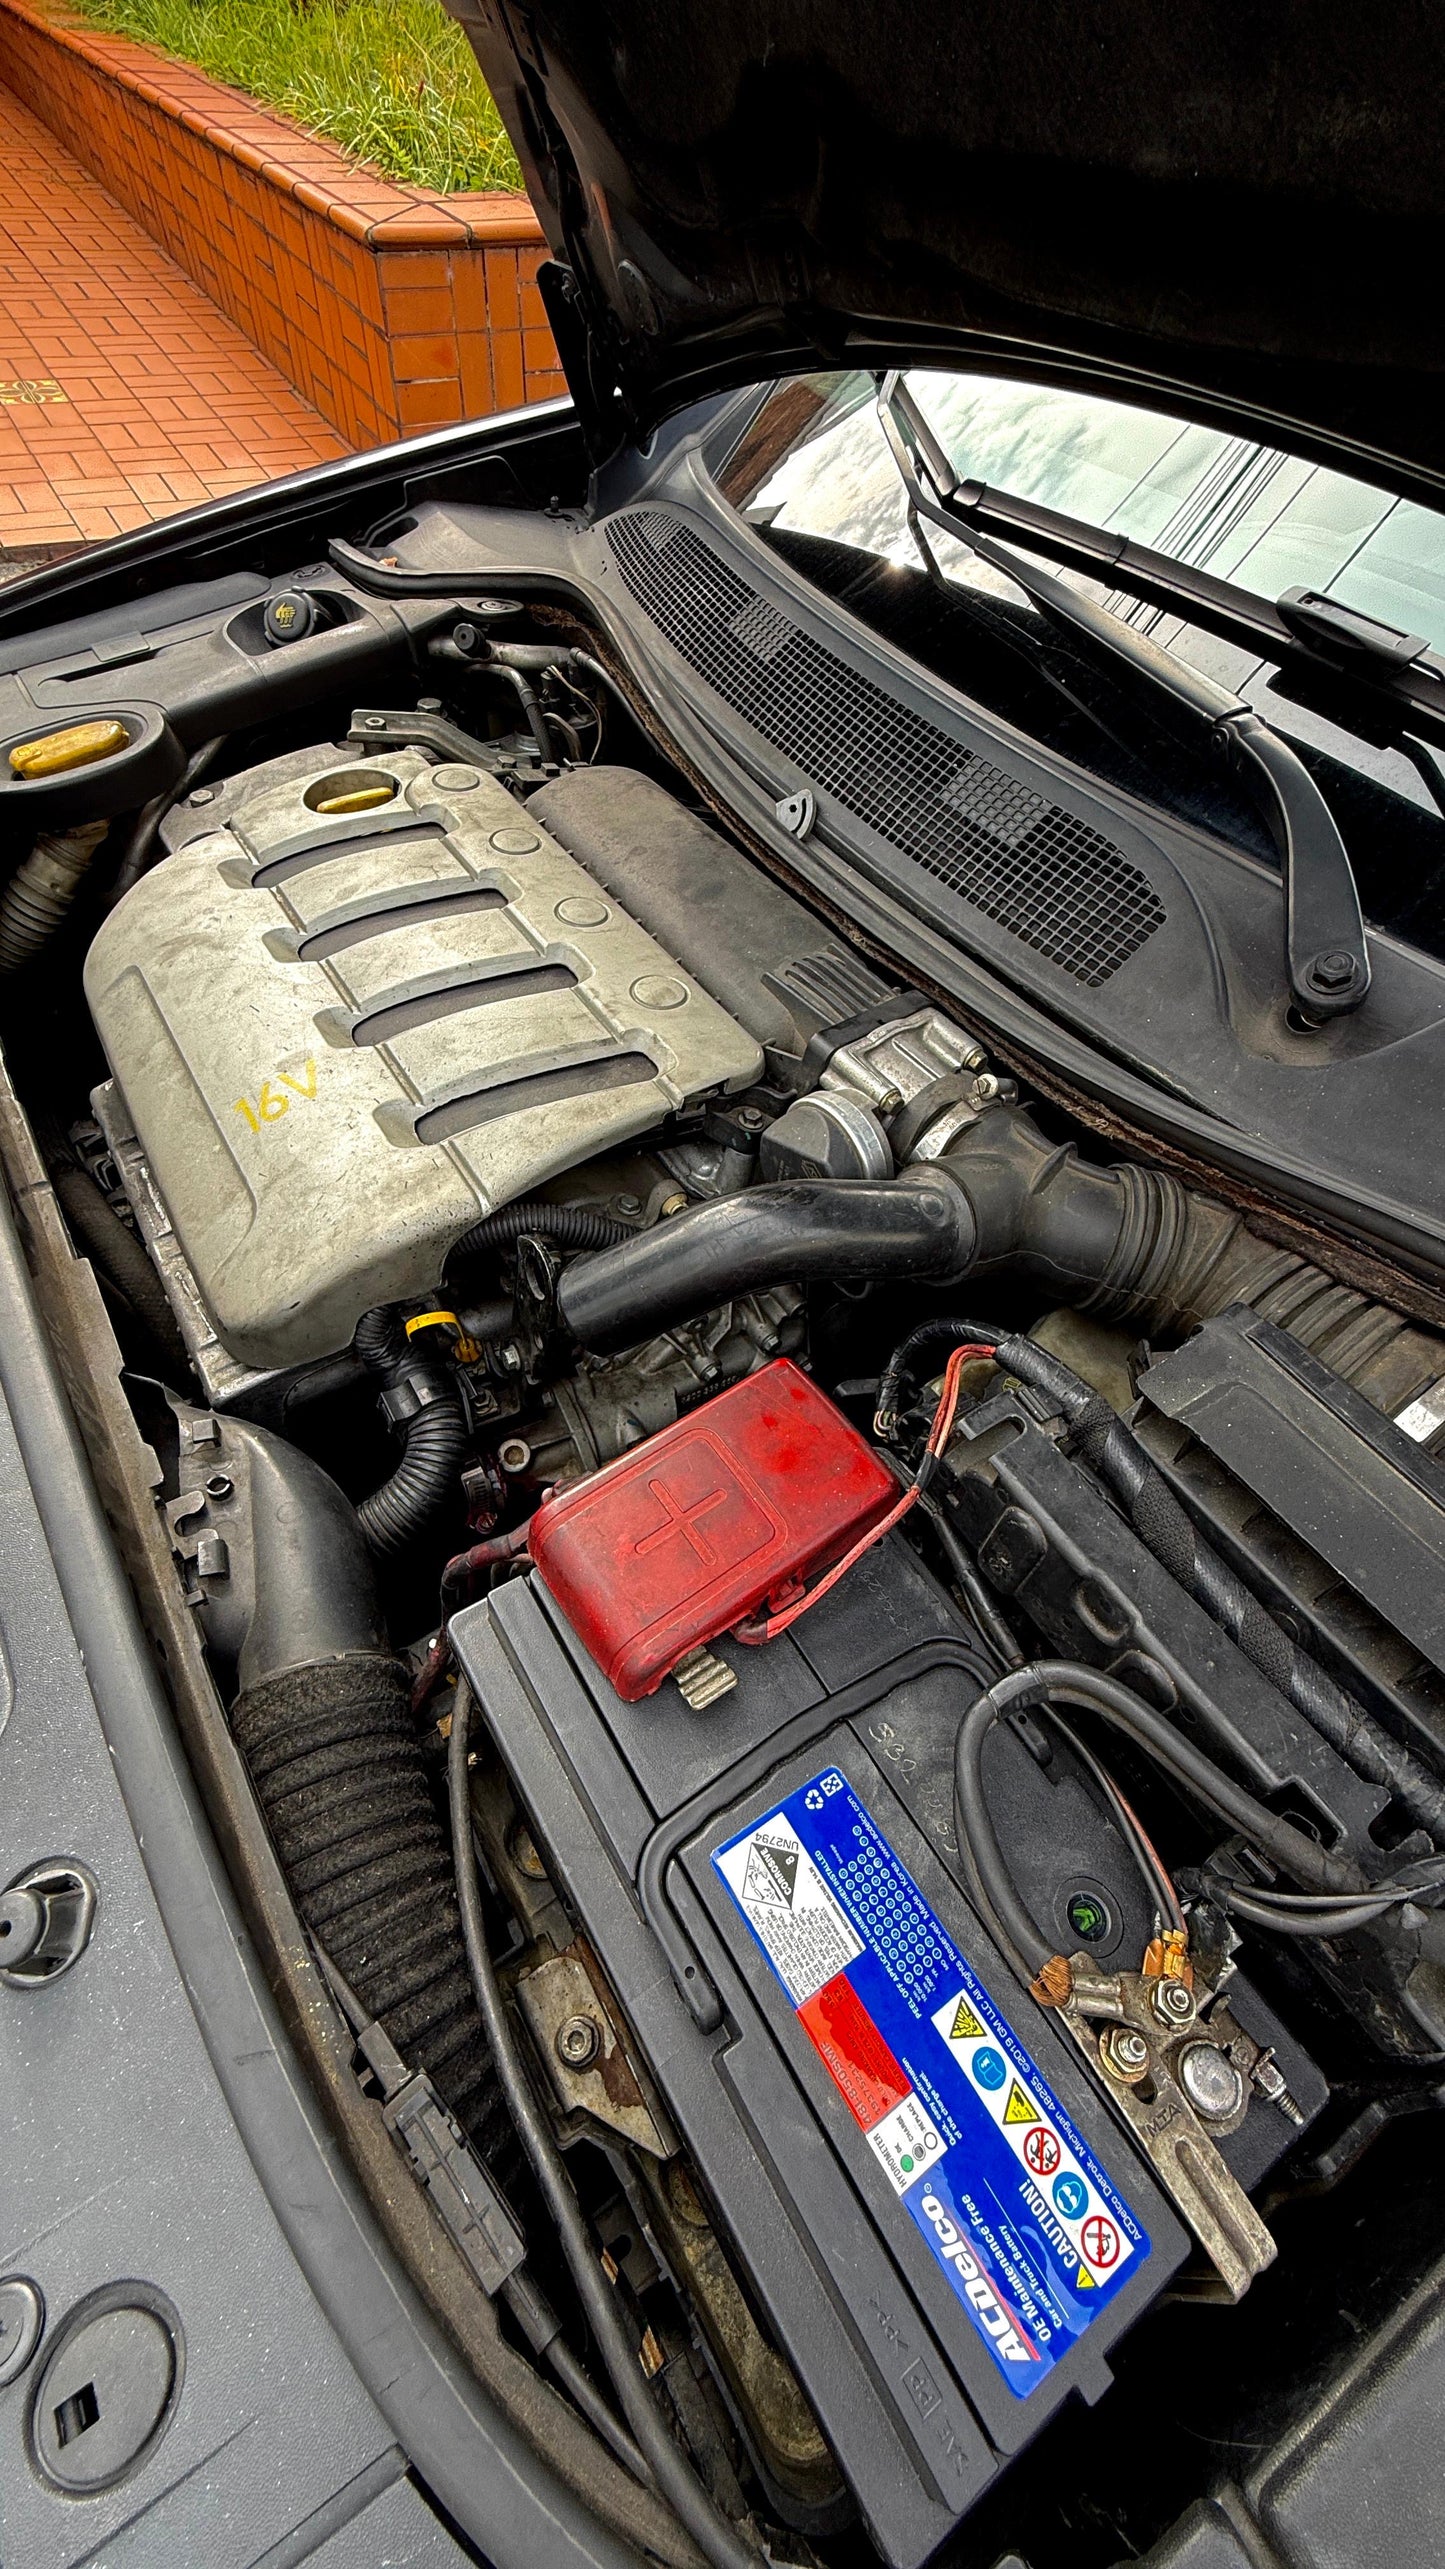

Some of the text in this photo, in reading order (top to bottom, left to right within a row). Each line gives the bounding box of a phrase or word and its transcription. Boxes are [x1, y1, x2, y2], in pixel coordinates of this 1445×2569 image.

[233, 1058, 319, 1135] 16V
[755, 1832, 799, 1852] UN2794
[844, 1794, 892, 1860] www.acdelco.com
[759, 1846, 793, 1896] CORROSIVE
[785, 1855, 795, 1865] 8
[814, 1849, 840, 1886] INSTALLED
[836, 1885, 853, 1908] WHEN
[904, 1885, 914, 1896] in
[909, 1893, 930, 1920] Made
[852, 1910, 871, 1937] NUMBER
[927, 1919, 958, 1961] Reserved.
[868, 1936, 899, 1982] APPLICABLE
[953, 1958, 977, 1989] Rights
[896, 1980, 909, 1998] OFF
[906, 1996, 922, 2018] PEEL
[972, 1987, 984, 2001] All
[980, 1999, 996, 2020] LLC
[992, 2017, 1008, 2038] GM
[1003, 2035, 1032, 2074] ©2019
[900, 2056, 957, 2146] Quick, easy confirmation
[918, 2070, 962, 2140] of the charge level.
[1028, 2071, 1057, 2113] 48265,
[1052, 2108, 1087, 2157] Michigan
[1145, 2103, 1183, 2139] MTA
[872, 2132, 907, 2188] HYDROMETER
[1083, 2154, 1113, 2197] Detroit,
[1017, 2177, 1079, 2270] CAUTION!
[1108, 2194, 1143, 2243] ACDelco
[921, 2195, 1030, 2361] ACDelco
[958, 2191, 1052, 2343] OE Maintenance Free
[996, 2221, 1063, 2330] Car and Truck Battery
